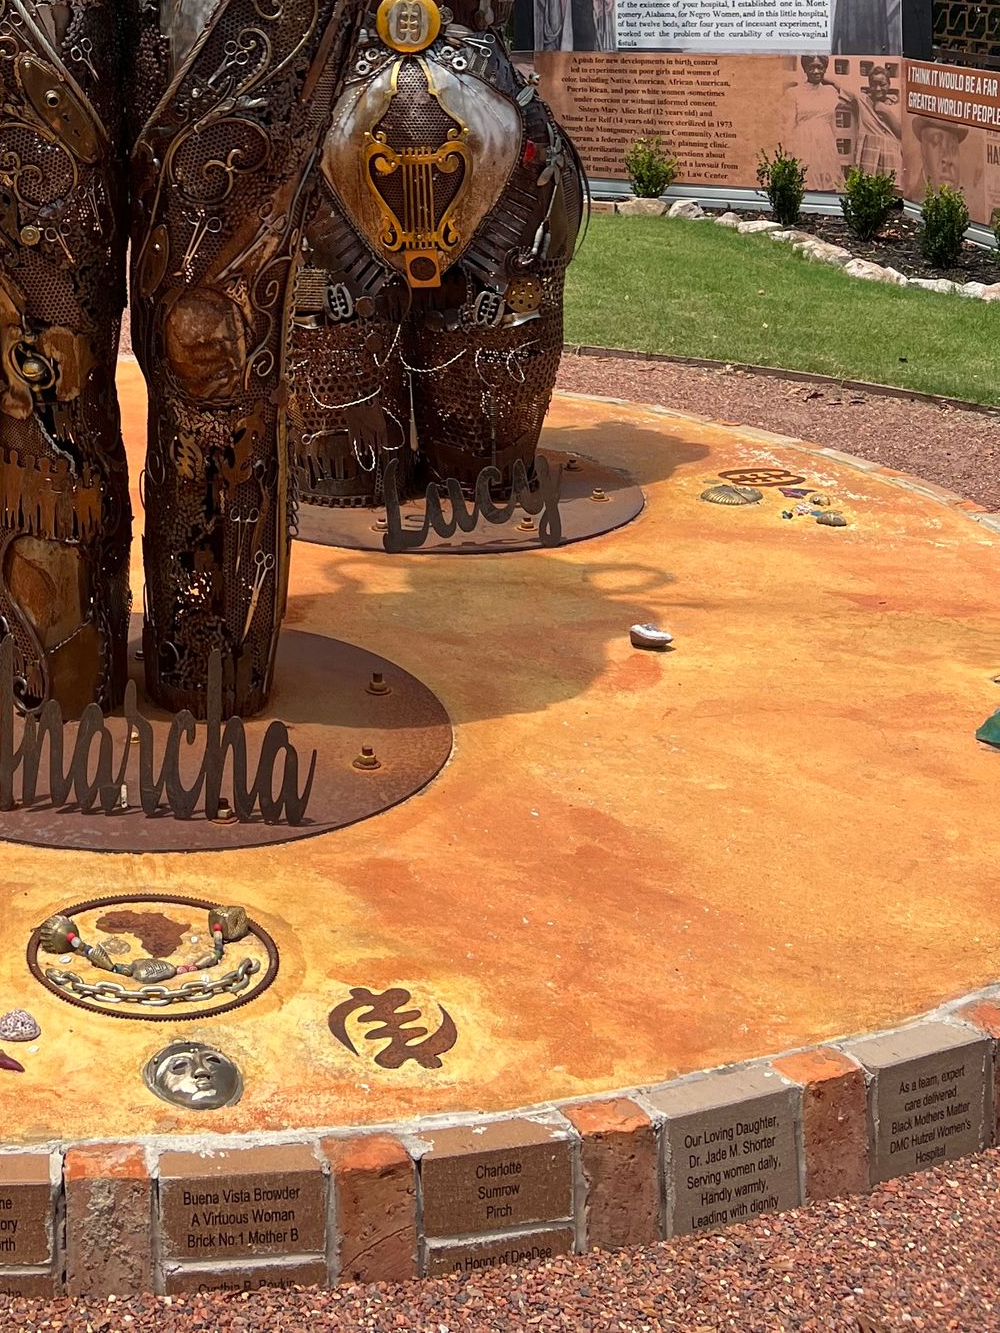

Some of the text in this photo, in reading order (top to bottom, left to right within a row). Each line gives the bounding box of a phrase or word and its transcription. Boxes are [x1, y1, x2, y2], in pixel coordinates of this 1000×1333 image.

[645, 11, 677, 19] Alabama,
[689, 11, 710, 19] Negro
[713, 10, 742, 18] Women,
[798, 10, 829, 18] hospital,
[700, 0, 729, 9] hospital,
[908, 66, 998, 97] I THINK IT WOULD BE A FAR
[908, 91, 1000, 125] GREATER WORLD IF PEOPLE
[383, 455, 563, 553] Lucy
[685, 1116, 779, 1148] Our Loving Daughter,
[689, 1155, 702, 1168] Dr.
[706, 1149, 726, 1165] Jade
[743, 1137, 776, 1154] Shorter
[476, 1162, 521, 1179] Charlotte
[687, 1155, 781, 1189] Serving women daily,
[183, 1186, 300, 1205] Buena Vista Browder
[478, 1185, 520, 1199] Sumrow
[701, 1178, 768, 1206] Handly warmly,
[191, 1209, 294, 1226] A Virtuous Woman
[487, 1204, 512, 1219] Pirch
[692, 1195, 779, 1229] Leading with dignity
[188, 1234, 215, 1248] Brick
[249, 1230, 287, 1243] Mother
[291, 1228, 298, 1241] B
